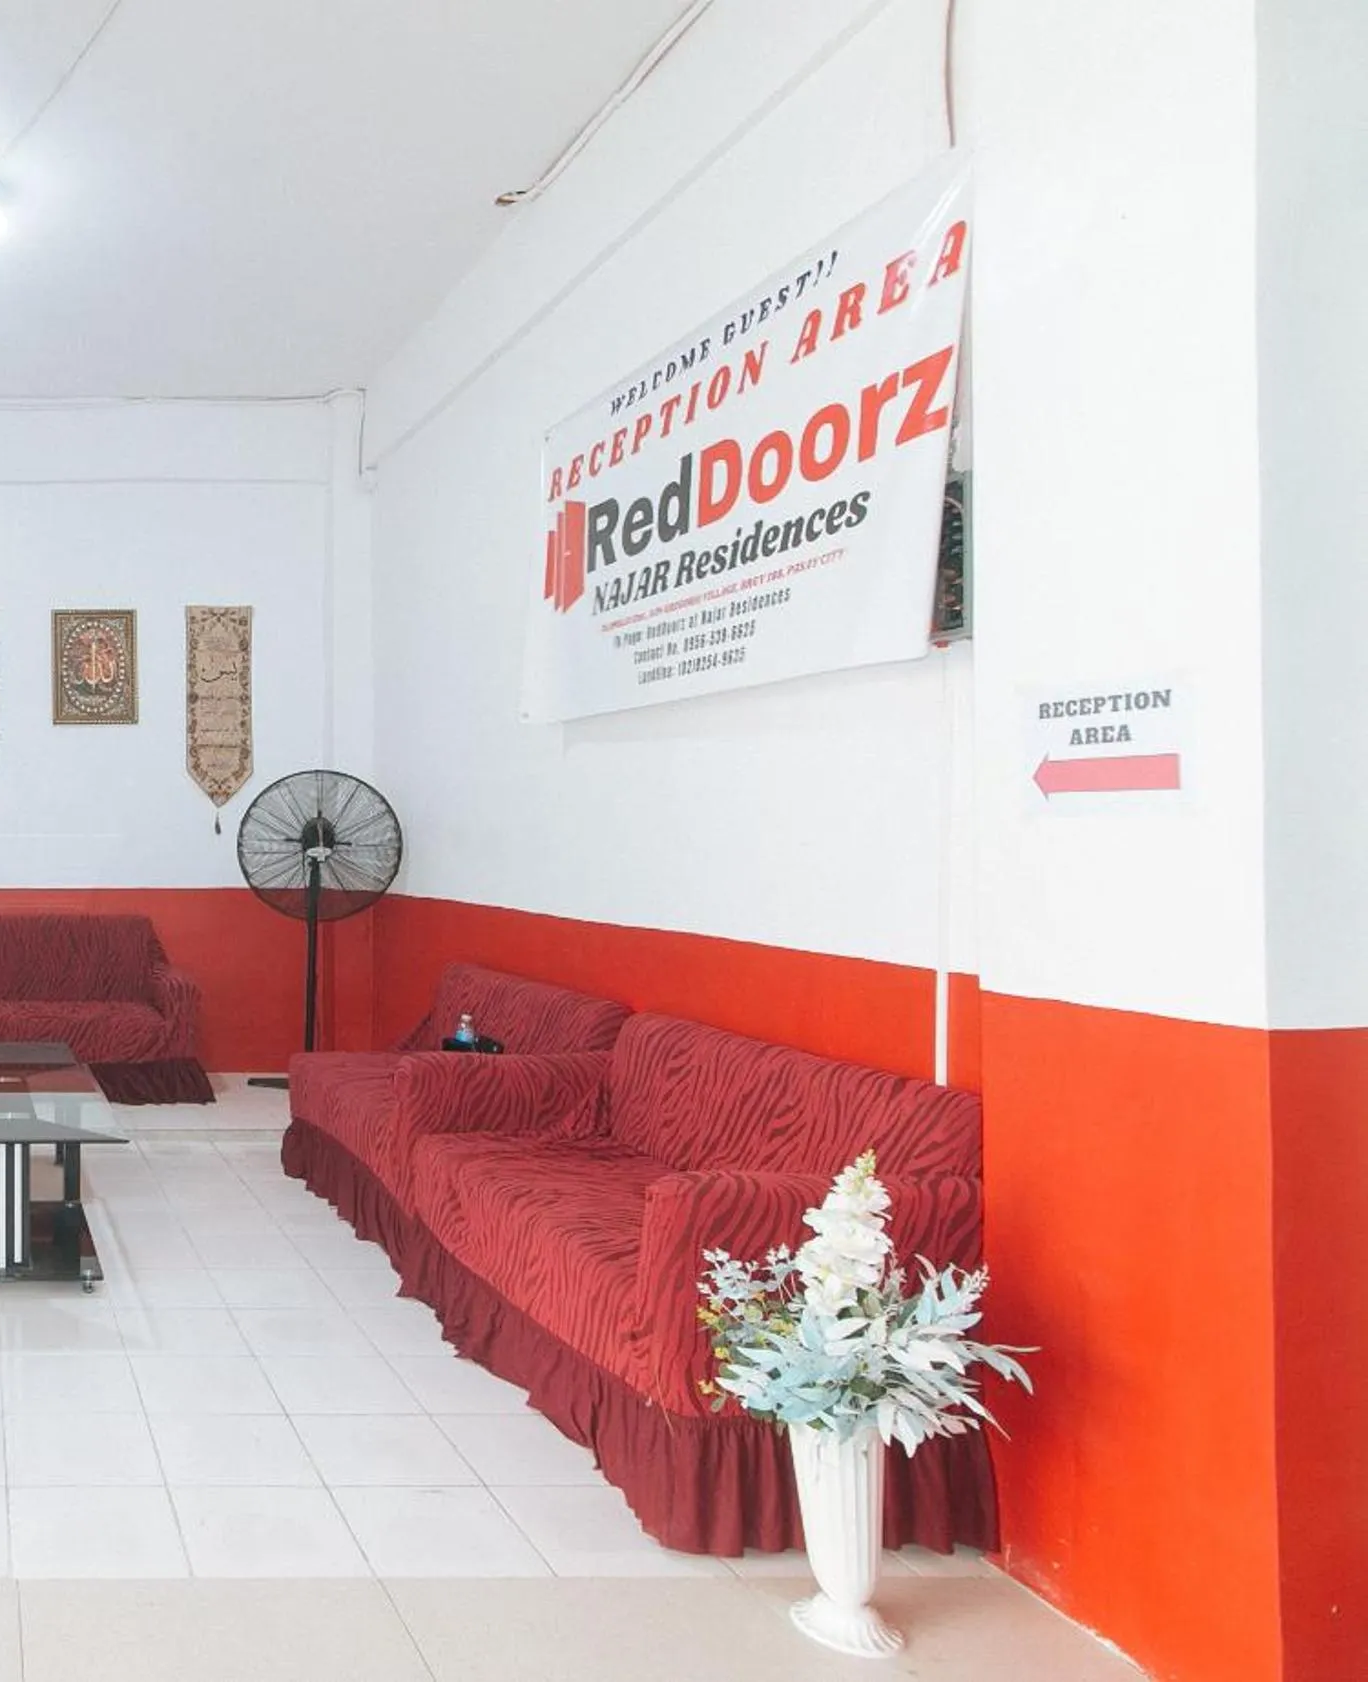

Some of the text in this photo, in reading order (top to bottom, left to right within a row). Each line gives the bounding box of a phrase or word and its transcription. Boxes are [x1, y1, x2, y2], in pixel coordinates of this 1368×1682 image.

[548, 219, 968, 502] RECEPTION AREA
[610, 250, 839, 416] WELCOME GUEST!!
[586, 344, 954, 574] RedDoorz
[592, 560, 670, 616] NAJAR
[674, 490, 871, 588] Residences
[729, 587, 792, 618] Residences
[1039, 689, 1172, 720] RECEPTION
[1069, 724, 1133, 746] AREA
